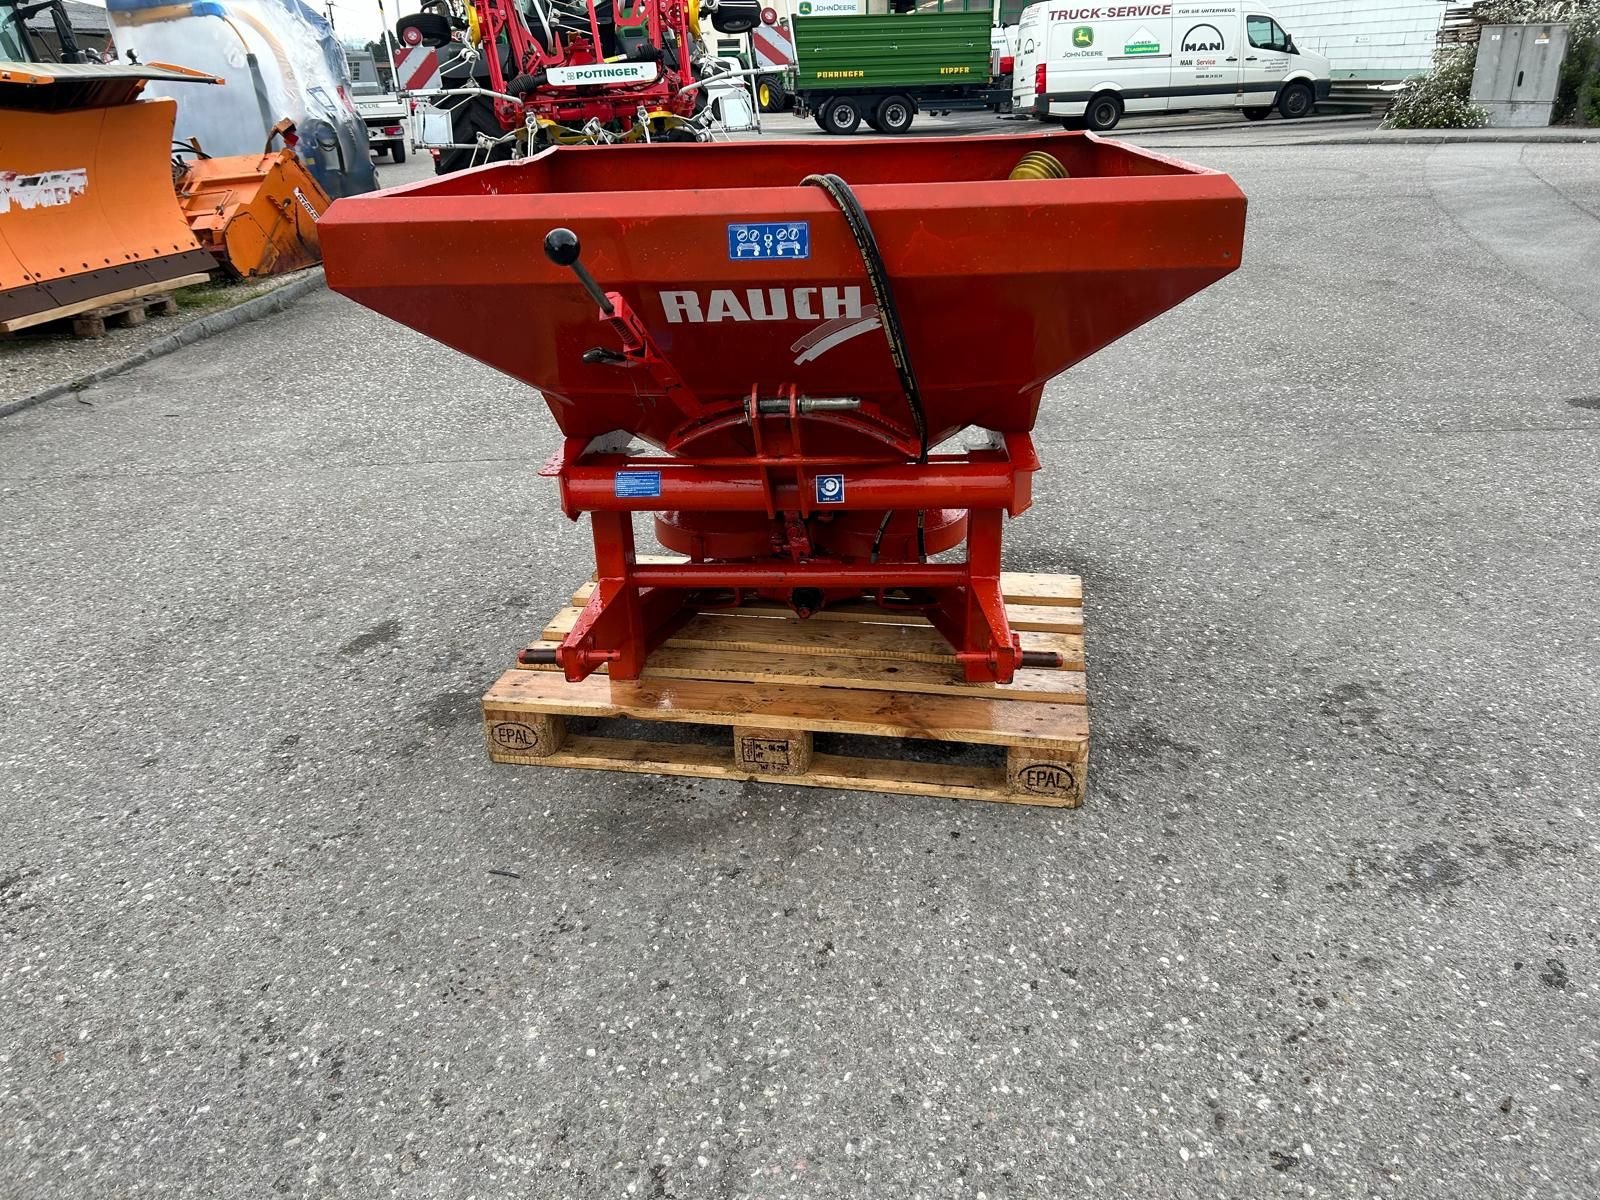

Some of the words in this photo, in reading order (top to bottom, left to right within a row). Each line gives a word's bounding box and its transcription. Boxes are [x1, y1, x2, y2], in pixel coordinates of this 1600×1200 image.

[1049, 5, 1172, 21] TRUCK-SERVICE
[1184, 43, 1221, 52] MAN
[1196, 58, 1217, 66] Service
[940, 66, 970, 75] KIPPER
[659, 286, 862, 323] RAUCH
[498, 727, 533, 745] EPAL
[1027, 770, 1065, 790] EPAL
